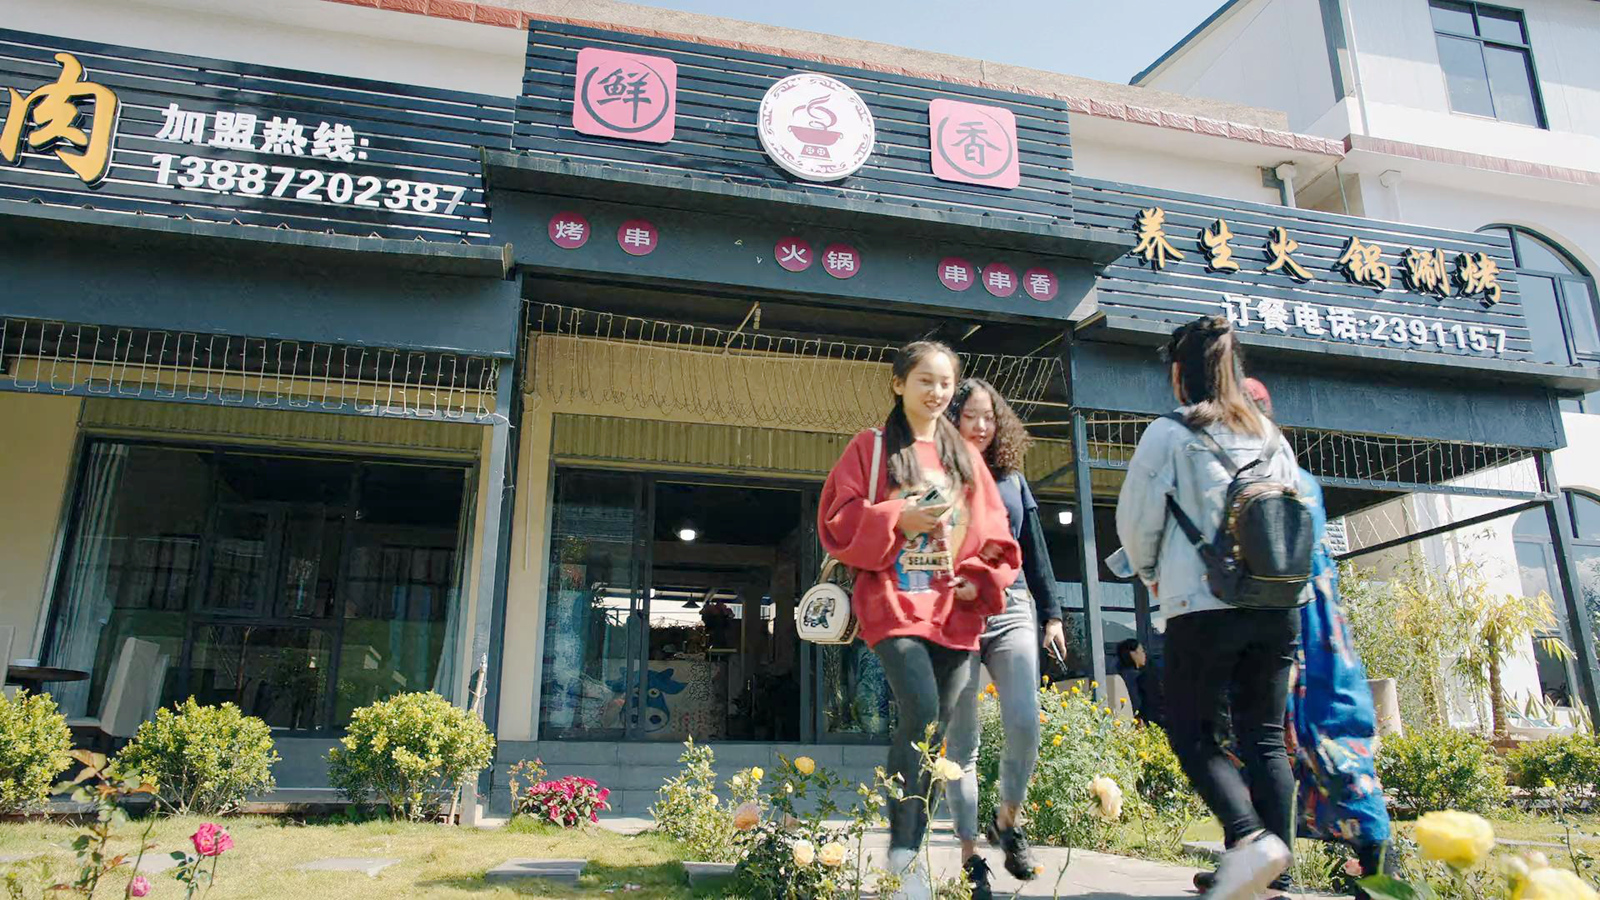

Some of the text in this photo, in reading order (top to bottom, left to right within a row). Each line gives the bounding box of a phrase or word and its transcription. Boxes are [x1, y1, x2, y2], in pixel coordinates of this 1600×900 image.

[0, 50, 121, 187] 肉
[596, 68, 652, 124] 鲜
[157, 103, 369, 161] 加盟热线:
[952, 122, 1001, 166] 香
[152, 154, 466, 216] 13887202387
[554, 220, 651, 247] 烤串
[781, 243, 857, 273] 火锅
[1134, 206, 1502, 308] 养生火锅涮烤
[944, 265, 1051, 295] 串串香
